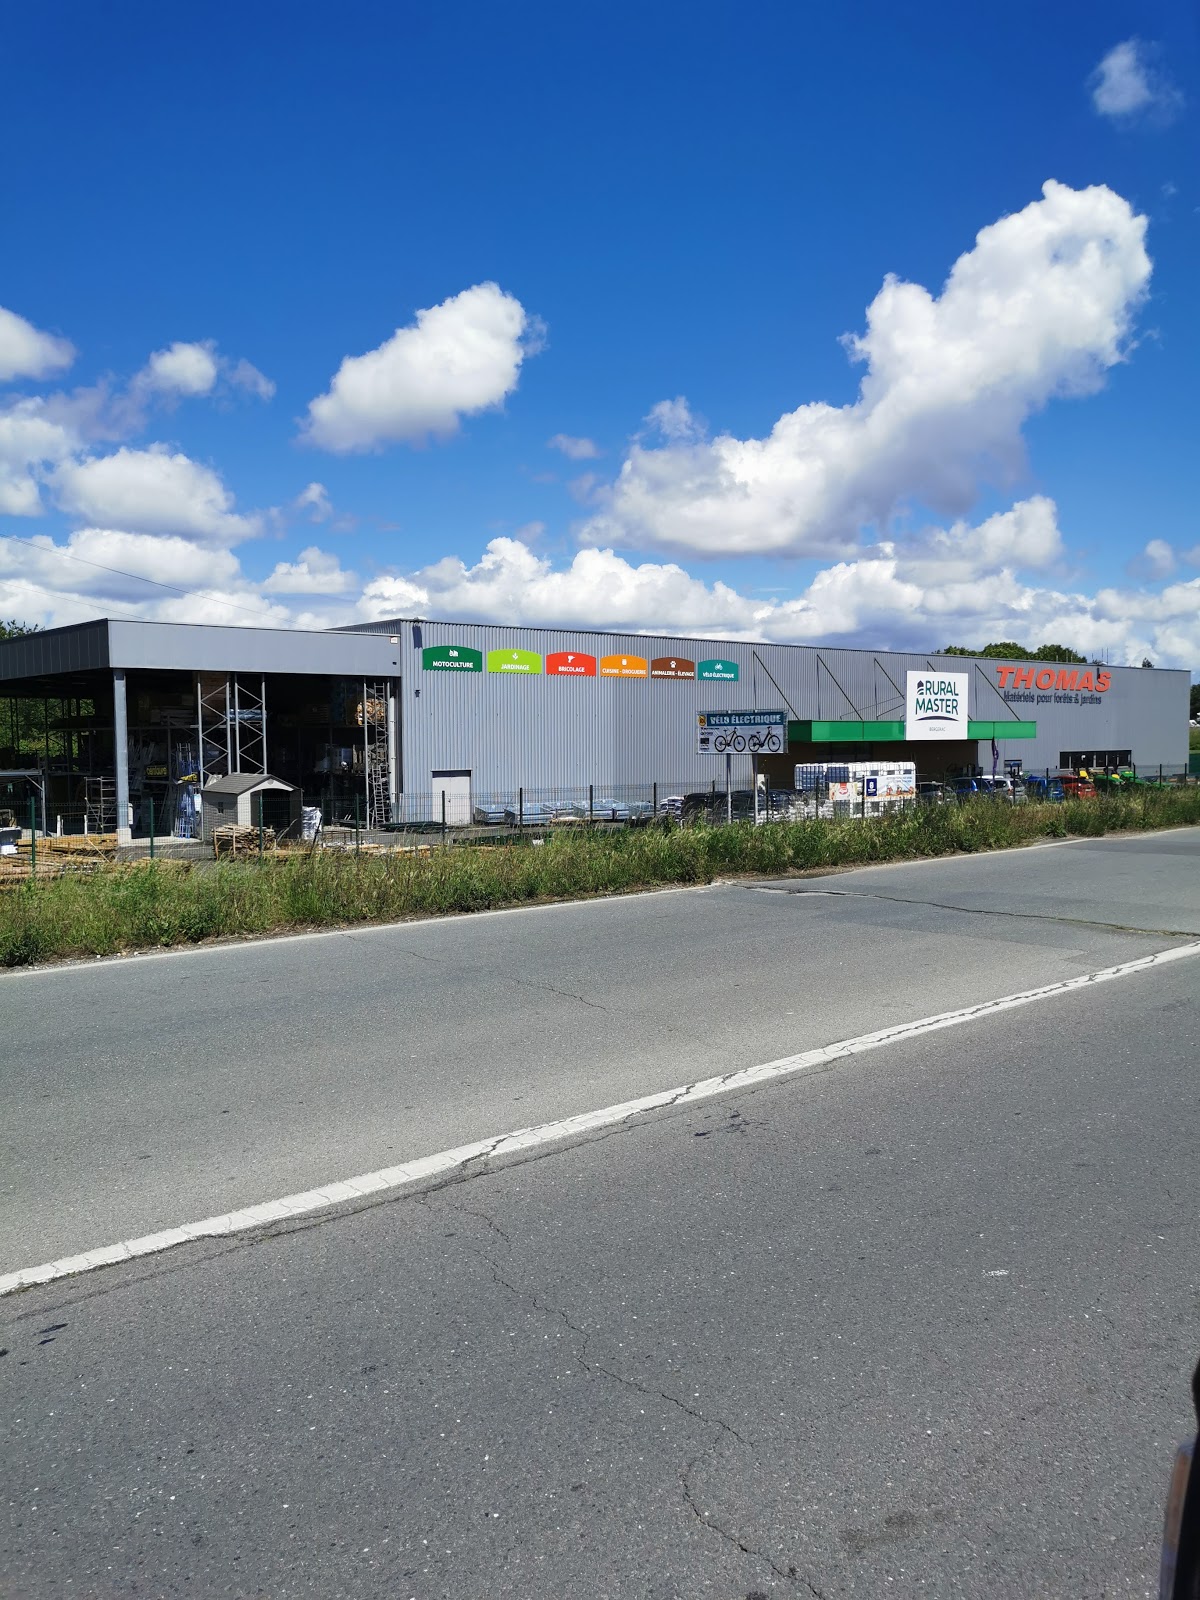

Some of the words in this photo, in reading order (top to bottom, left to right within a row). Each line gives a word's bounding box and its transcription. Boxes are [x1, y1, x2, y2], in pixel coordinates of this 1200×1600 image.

[433, 660, 473, 668] MOTOCULTURE
[996, 665, 1112, 693] THOMAS
[925, 680, 959, 696] RURAL
[1004, 690, 1035, 703] Matériels
[1036, 694, 1052, 705] pour
[1054, 692, 1072, 704] forêts
[1080, 694, 1102, 706] jardins
[915, 698, 959, 715] MASTER
[710, 715, 730, 724] VÉLO
[731, 714, 781, 724] ÉLECTRIQUE
